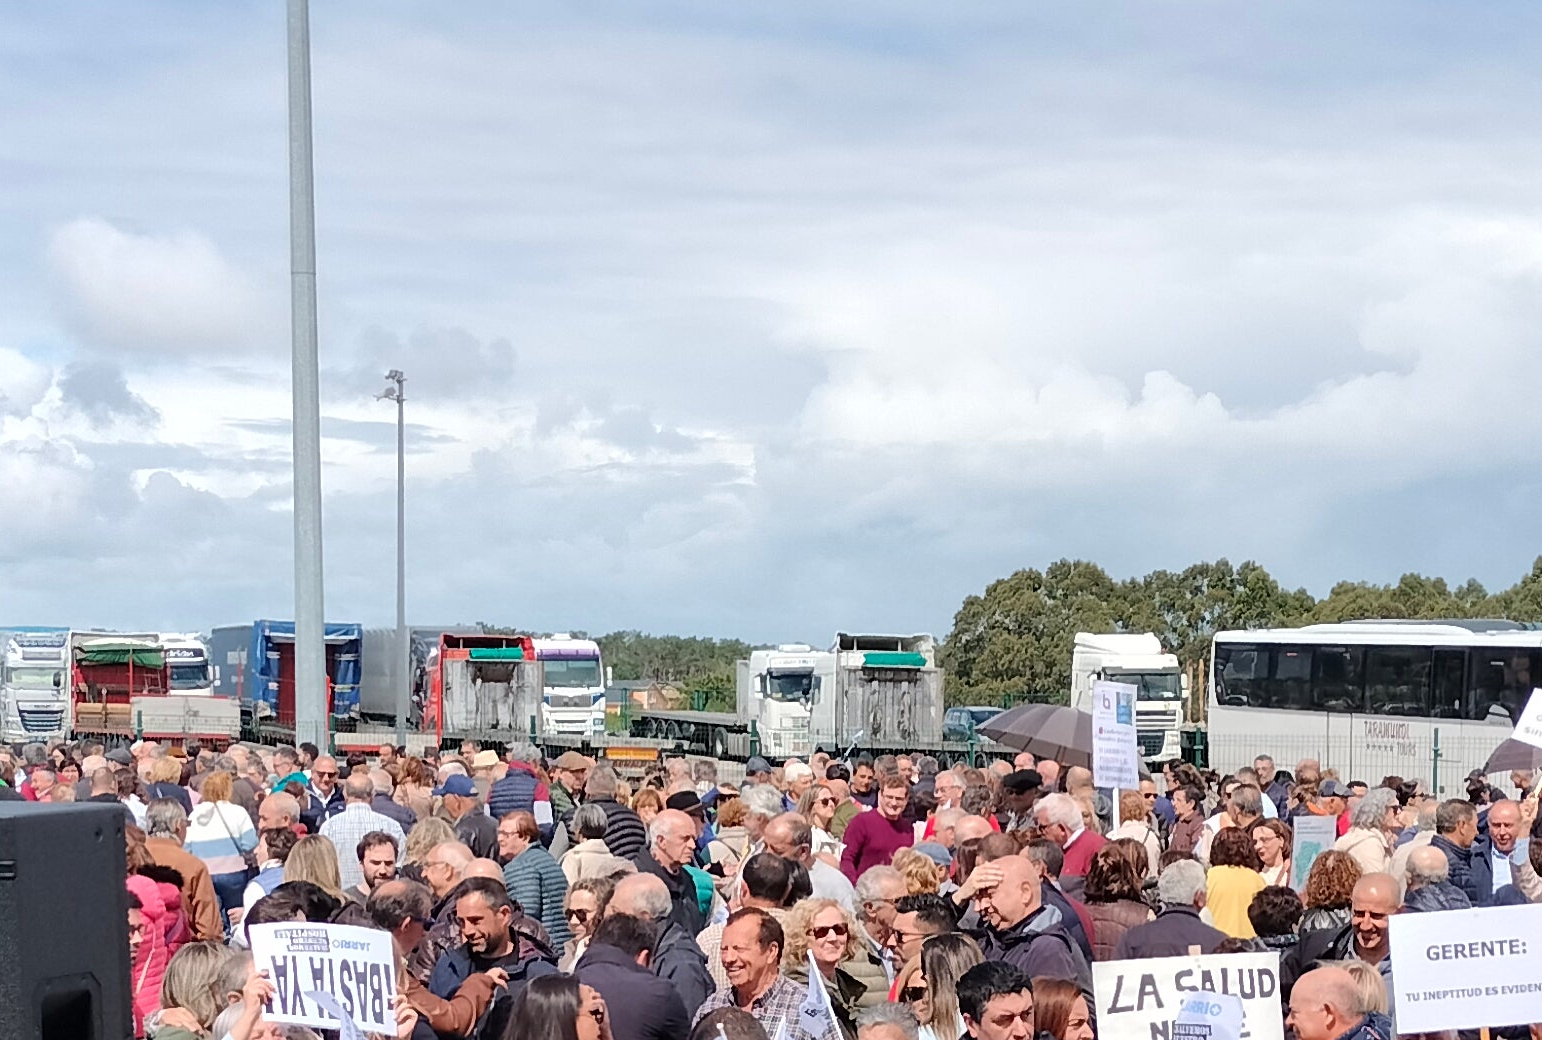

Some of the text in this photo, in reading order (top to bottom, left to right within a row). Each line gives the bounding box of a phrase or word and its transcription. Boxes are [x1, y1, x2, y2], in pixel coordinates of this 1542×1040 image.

[1524, 726, 1542, 737] sin
[332, 939, 371, 952] JARRIO
[1426, 938, 1528, 962] GERENTE:
[1107, 967, 1276, 1015] LA SALUD
[1406, 992, 1420, 1003] TU
[1423, 987, 1483, 1002] INEPTITUD
[1485, 985, 1499, 996] ES
